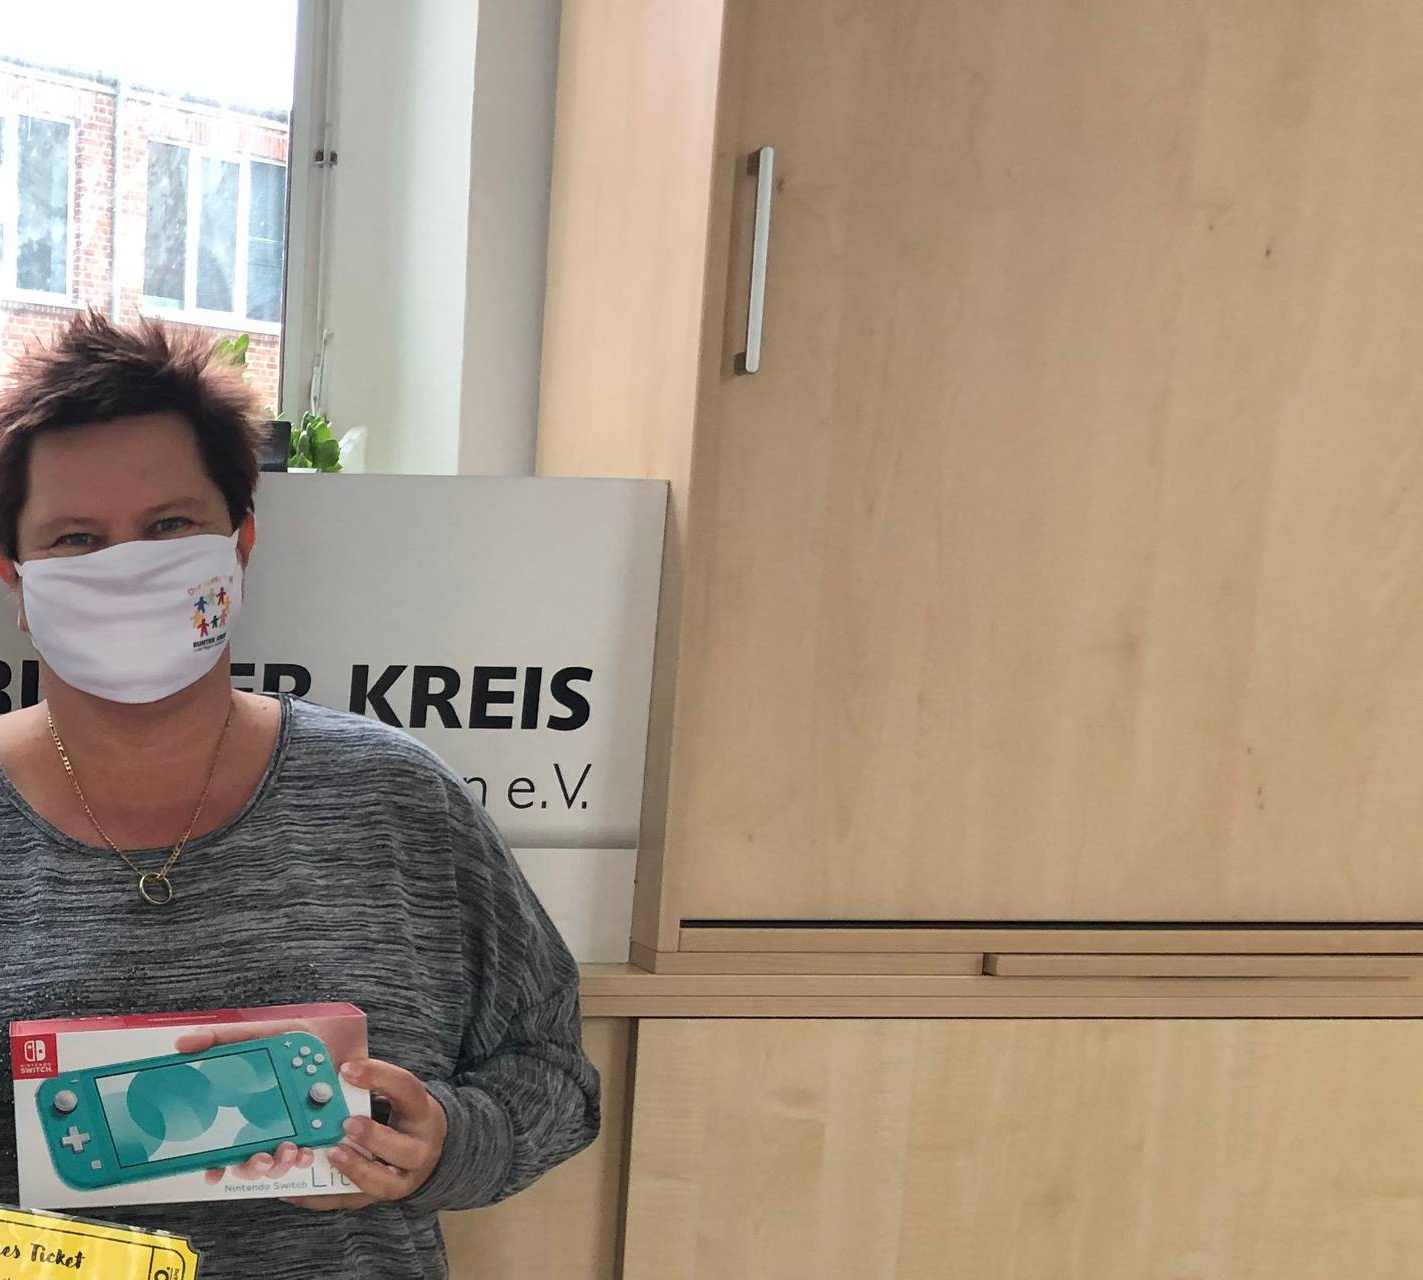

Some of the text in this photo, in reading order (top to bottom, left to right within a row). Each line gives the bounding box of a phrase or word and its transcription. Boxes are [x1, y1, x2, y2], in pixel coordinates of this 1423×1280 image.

[348, 664, 594, 731] KREIS
[507, 763, 592, 810] e.V.
[20, 1066, 53, 1074] SWITCH
[224, 1166, 351, 1193] Nintendo Switch Lit
[30, 1242, 85, 1270] Ticket
